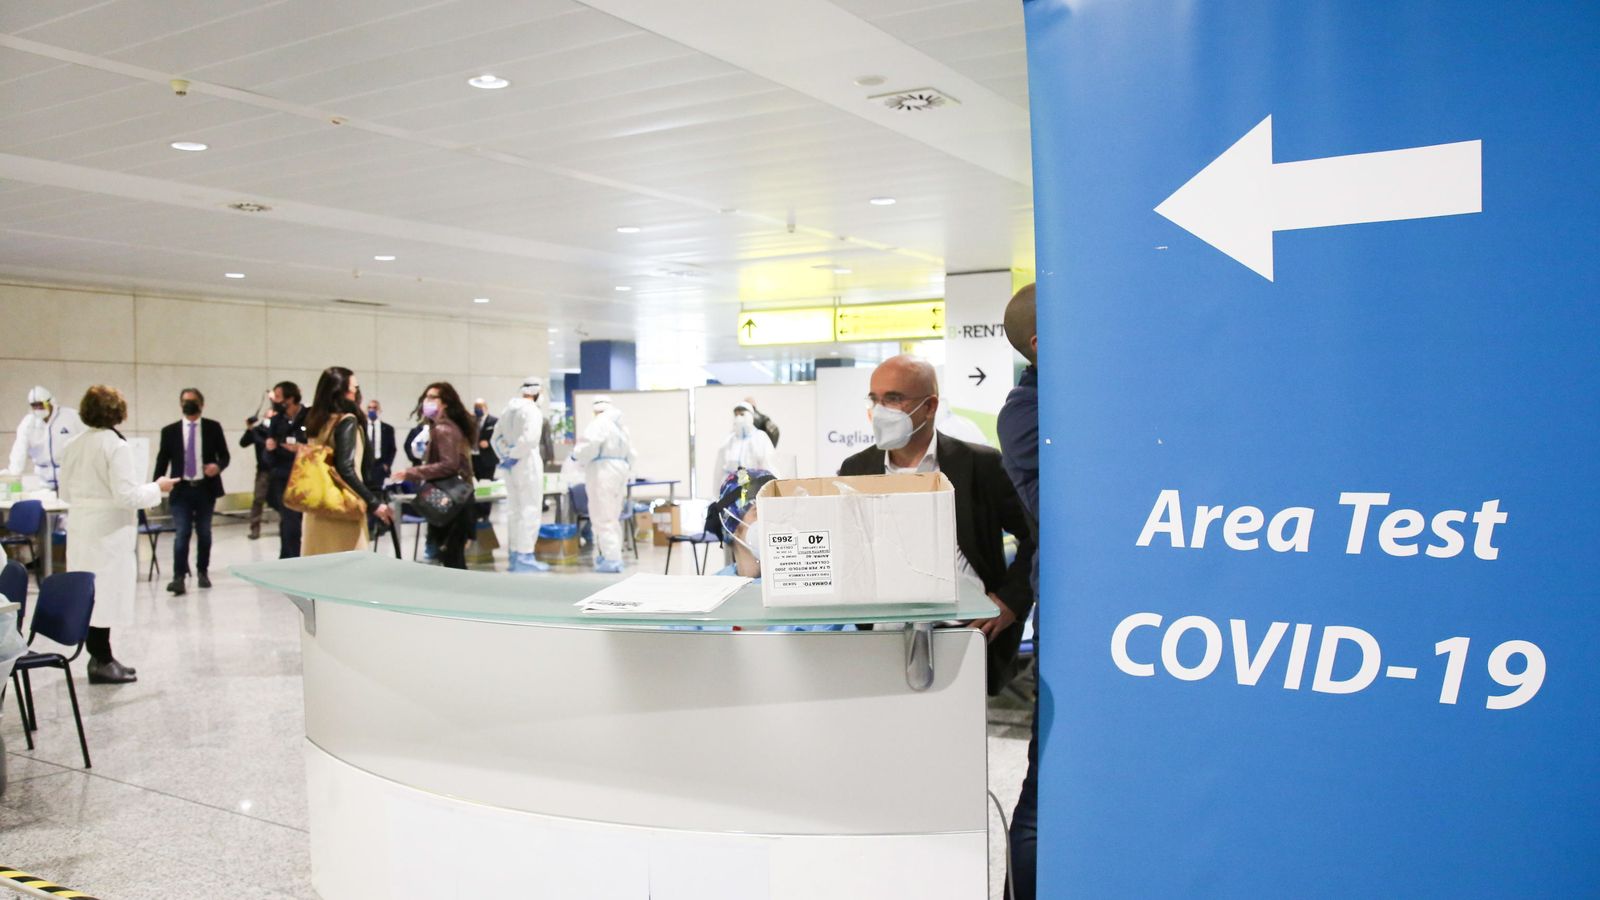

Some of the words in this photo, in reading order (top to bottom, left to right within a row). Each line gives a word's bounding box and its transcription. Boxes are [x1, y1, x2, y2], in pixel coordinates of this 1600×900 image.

[827, 430, 876, 447] Cagliar
[808, 535, 823, 544] 40
[1136, 489, 1315, 553] Area
[1338, 492, 1508, 561] Test
[1110, 612, 1547, 710] COVID-19
